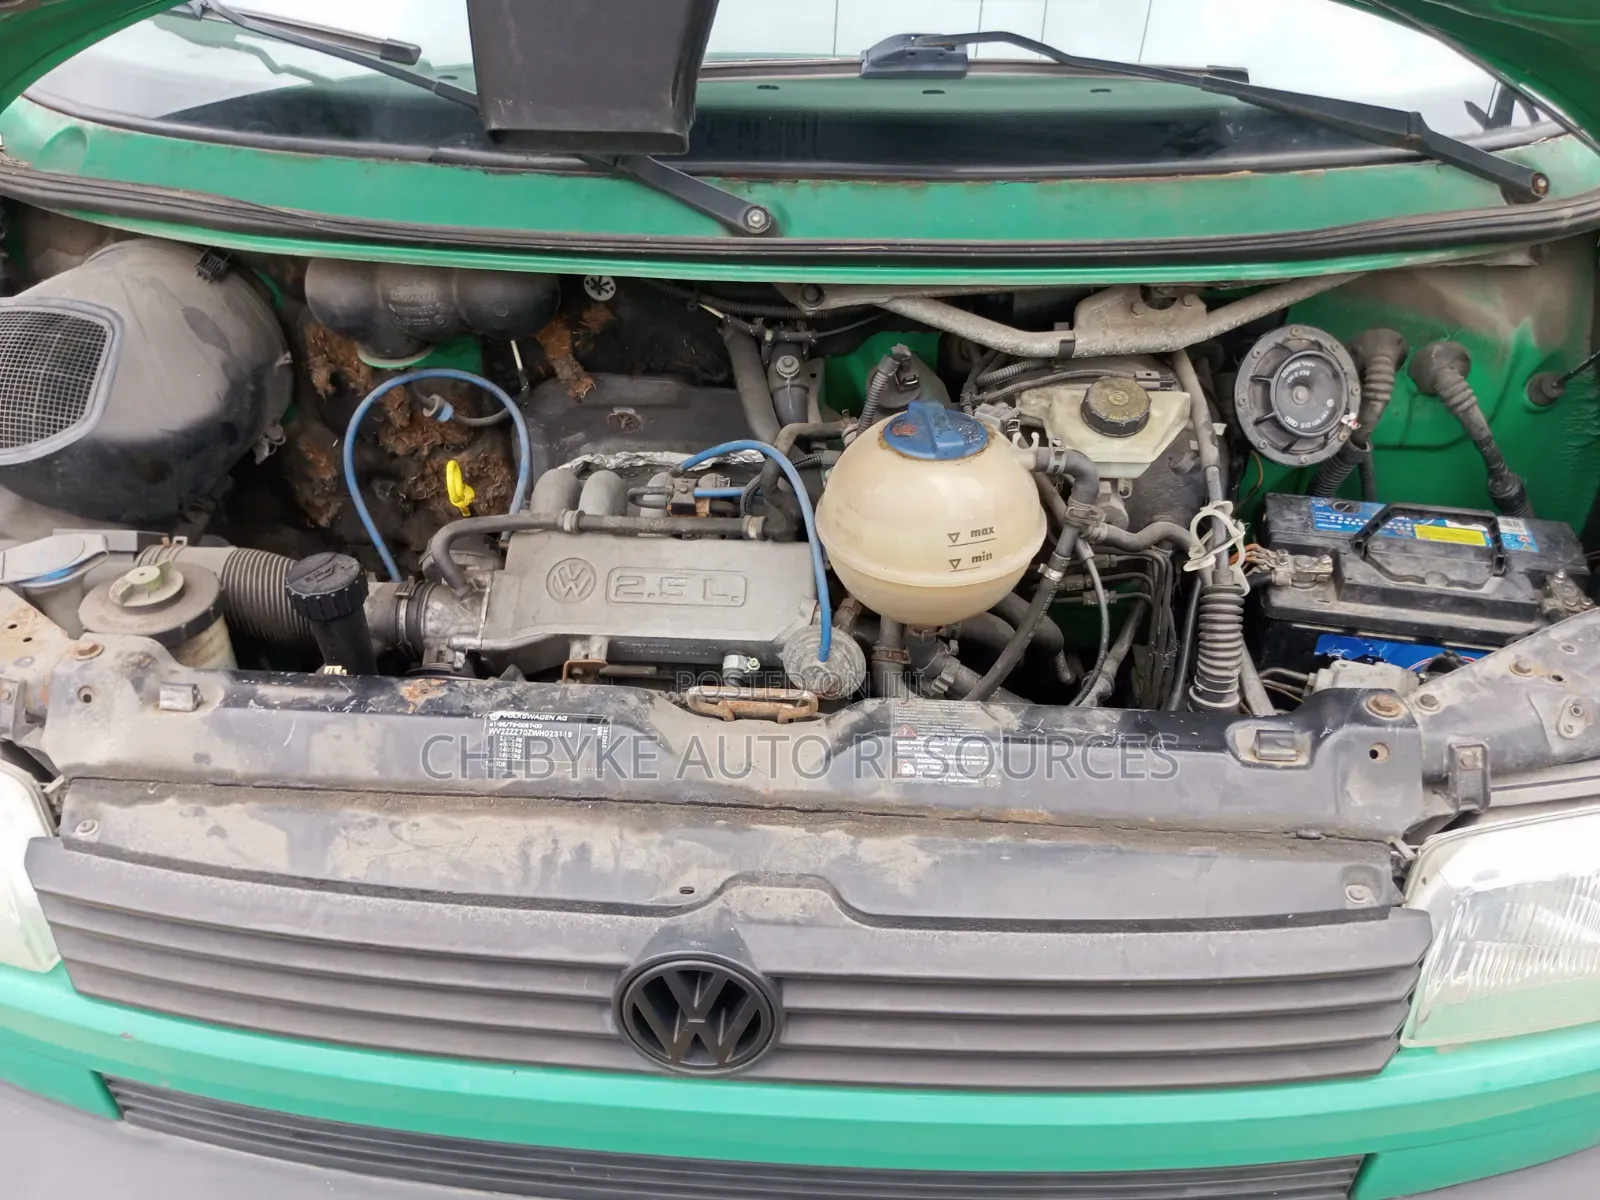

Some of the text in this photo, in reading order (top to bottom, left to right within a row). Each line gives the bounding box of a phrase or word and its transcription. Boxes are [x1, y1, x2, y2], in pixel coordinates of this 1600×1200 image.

[970, 525, 995, 538] max
[971, 550, 993, 564] min
[546, 557, 597, 602] VW
[614, 575, 692, 598] 2.5
[503, 712, 555, 721] VOLKSWAGEN
[618, 954, 778, 1073] VW
